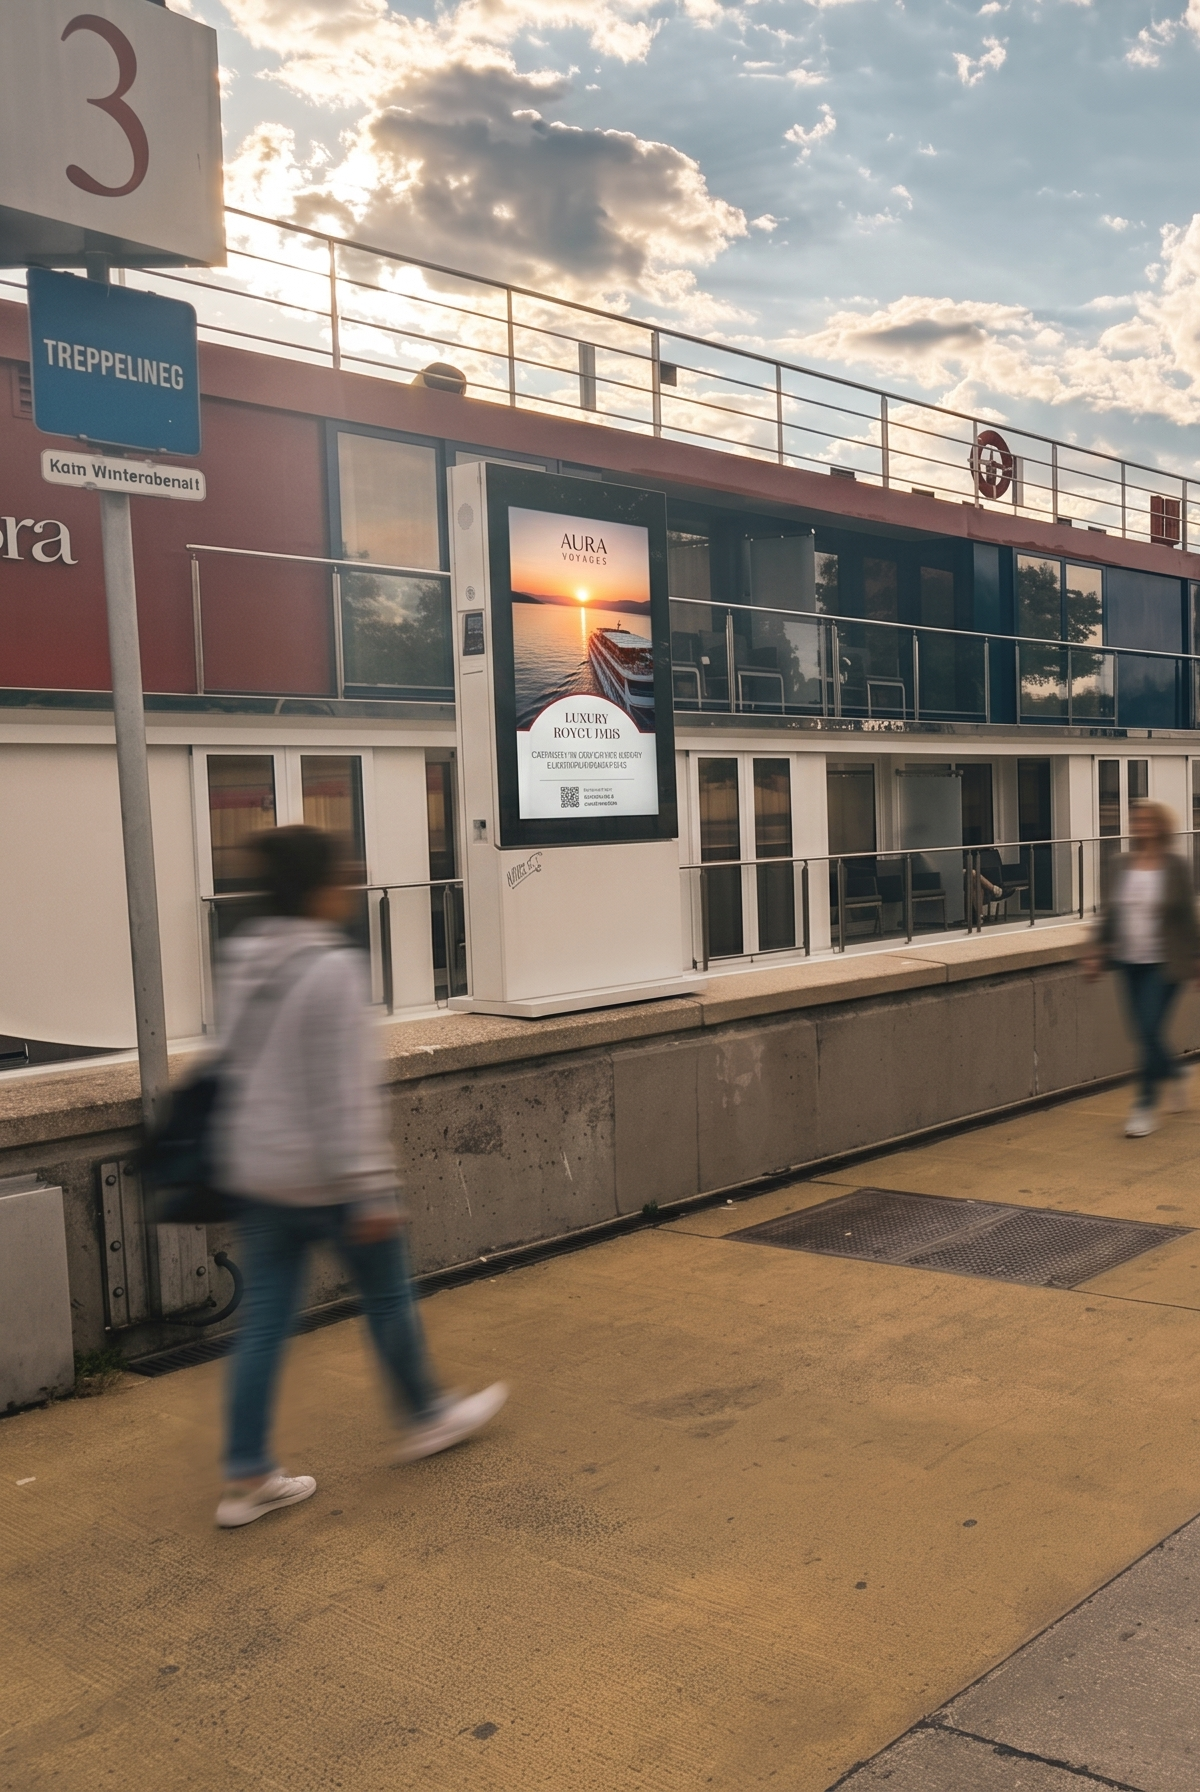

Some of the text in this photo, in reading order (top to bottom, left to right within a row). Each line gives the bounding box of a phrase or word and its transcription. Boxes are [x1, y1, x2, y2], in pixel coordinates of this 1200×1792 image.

[60, 13, 150, 198] 3
[43, 338, 184, 390] TREPPELINEG
[0, 514, 79, 566] ra
[560, 533, 608, 554] AURA
[562, 553, 608, 565] VOYAGES
[565, 712, 608, 724] LUXURY
